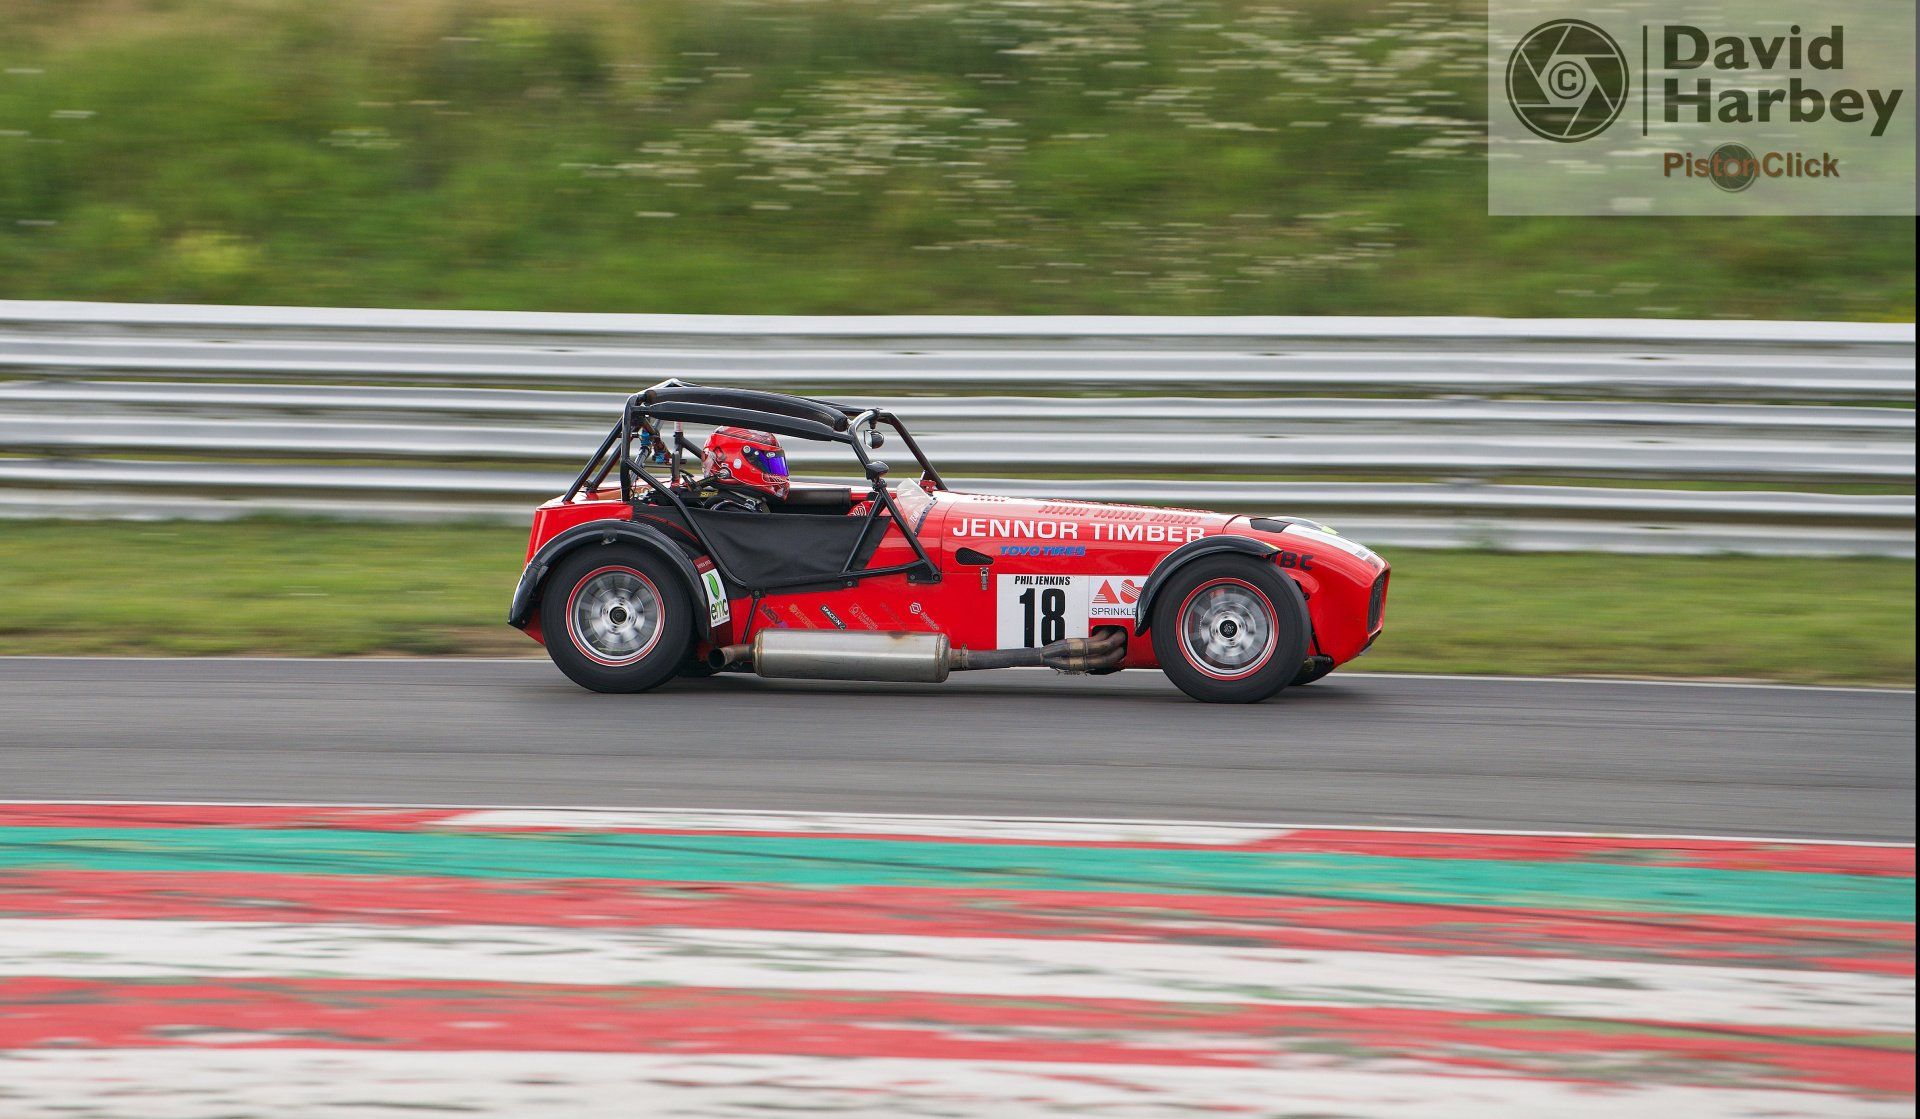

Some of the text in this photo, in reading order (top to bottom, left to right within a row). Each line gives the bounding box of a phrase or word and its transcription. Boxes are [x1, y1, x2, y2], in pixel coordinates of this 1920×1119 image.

[952, 517, 1205, 544] JENNOR TIMBER
[1001, 545, 1086, 557] TOYO TIRES
[1014, 575, 1071, 586] PHIL JENKINS
[1019, 587, 1066, 649] 18
